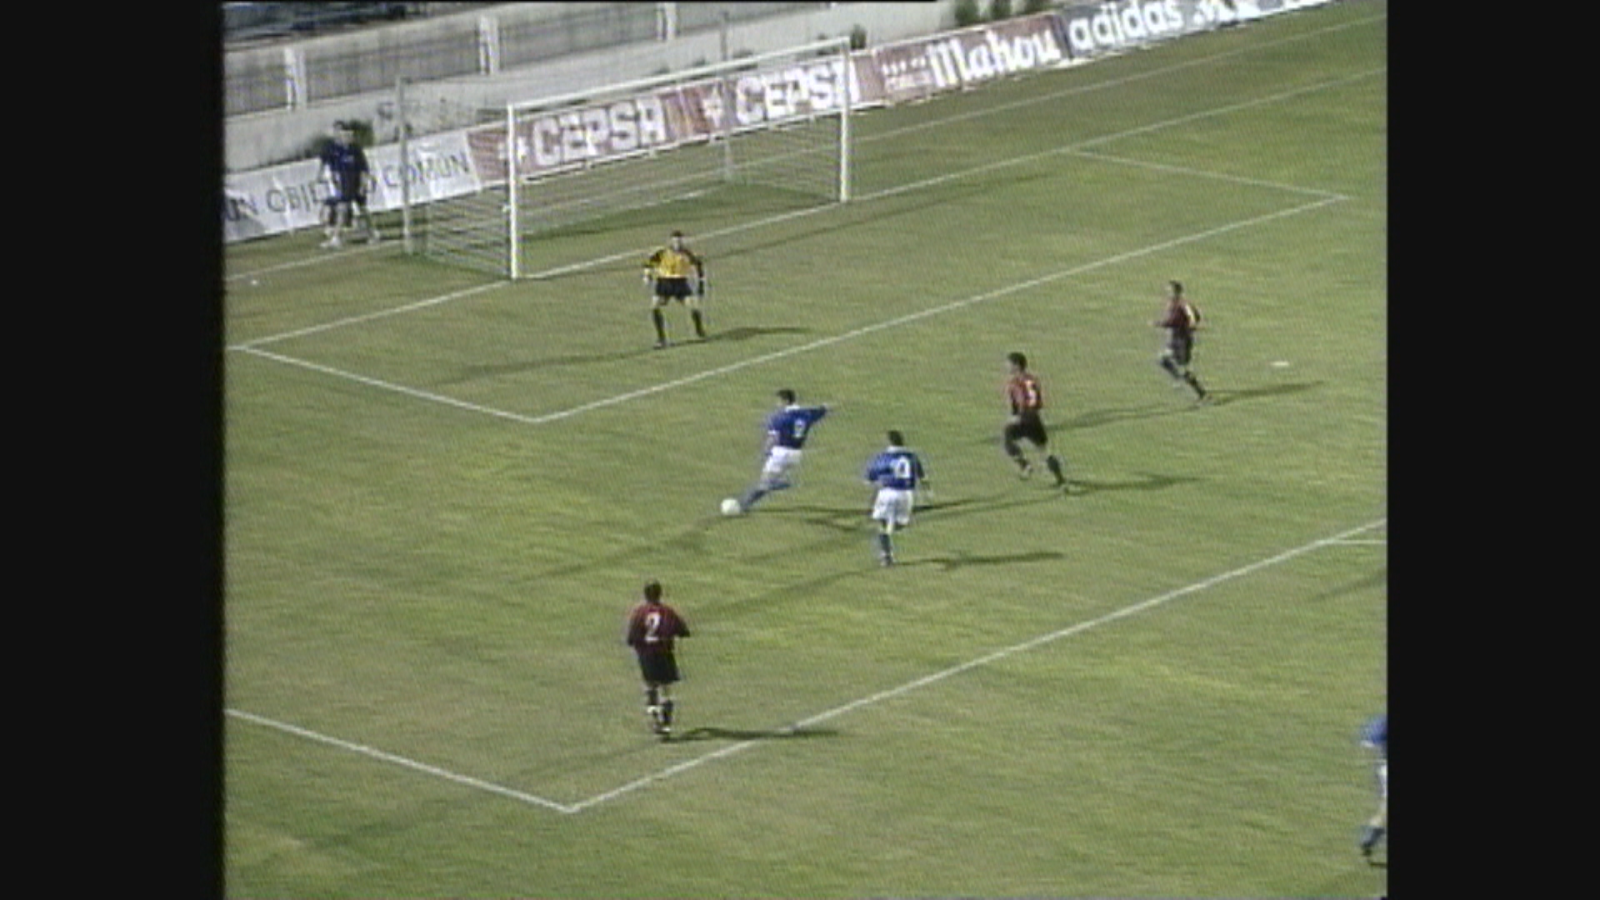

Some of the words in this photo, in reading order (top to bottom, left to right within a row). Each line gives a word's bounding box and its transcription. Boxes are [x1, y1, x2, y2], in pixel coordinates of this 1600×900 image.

[1069, 0, 1184, 50] adidas
[926, 29, 1061, 88] Mahou
[735, 59, 861, 125] CEPSA
[533, 97, 666, 166] CEPSA
[645, 612, 661, 642] 2
